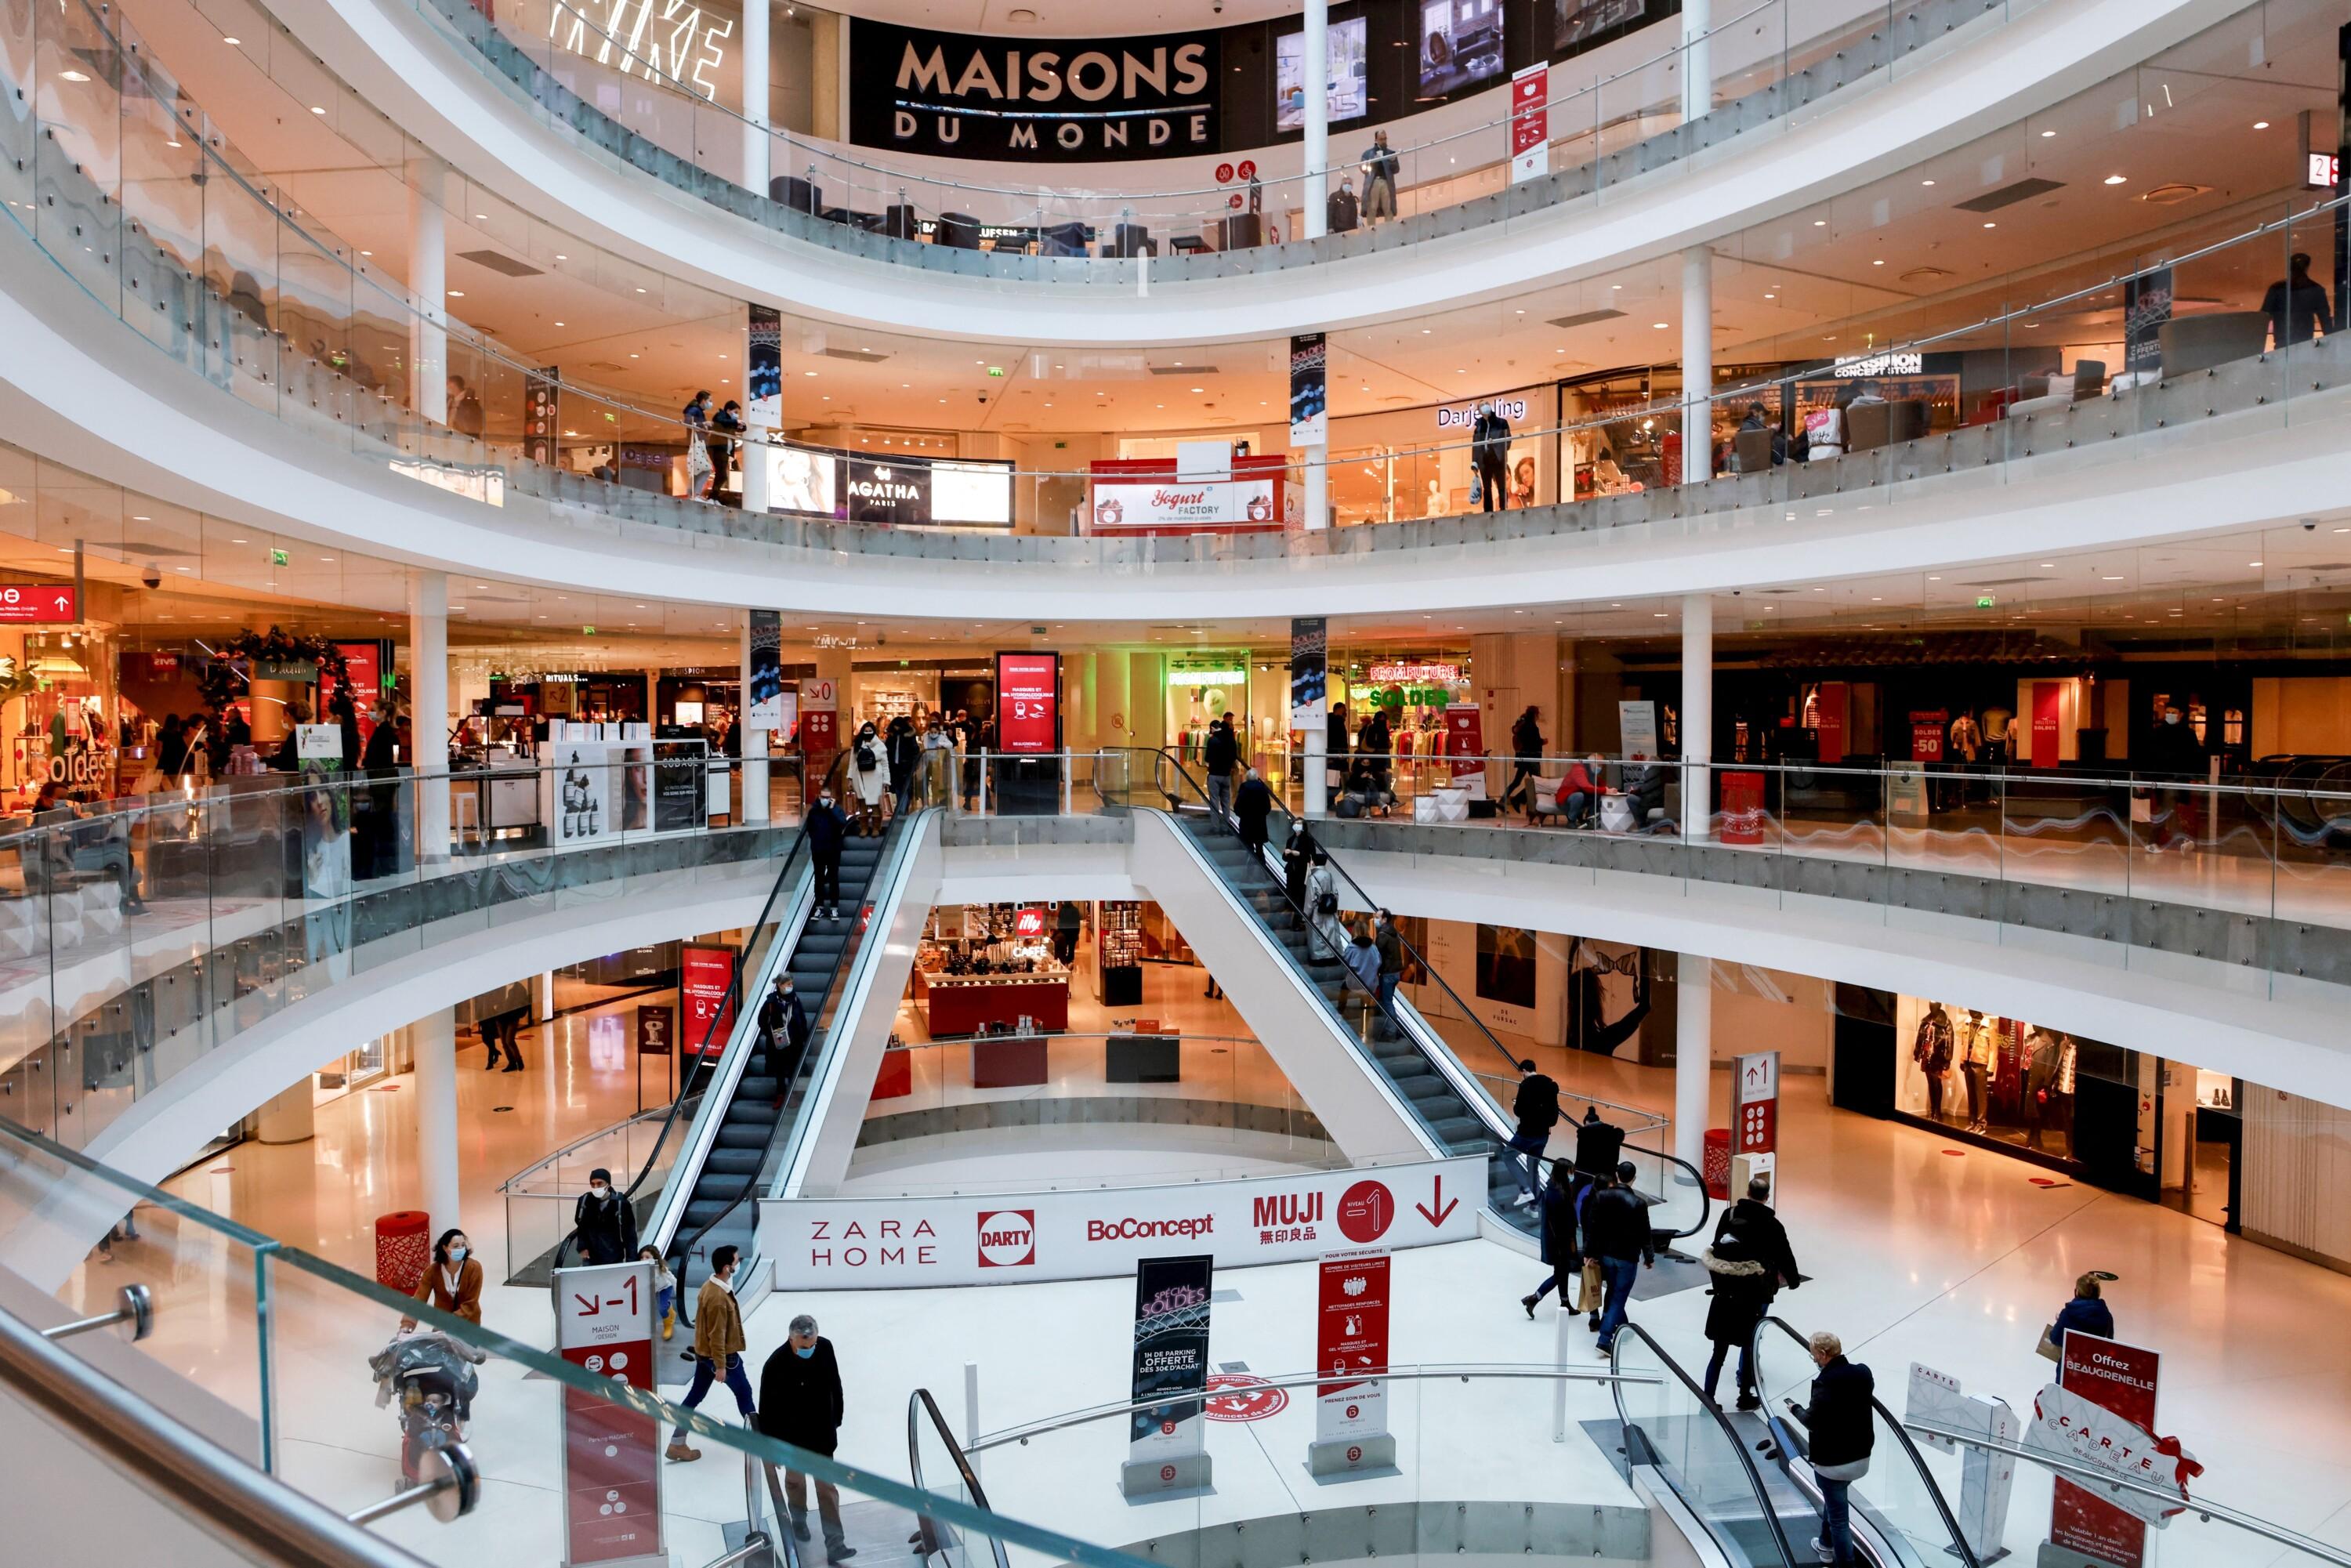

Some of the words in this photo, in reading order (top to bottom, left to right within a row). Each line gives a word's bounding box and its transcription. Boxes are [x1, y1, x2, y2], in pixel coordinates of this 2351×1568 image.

[895, 39, 1208, 102] MAISONS
[895, 110, 960, 143] DU
[1009, 114, 1208, 150] MONDE
[2316, 158, 2324, 176] 2
[1291, 343, 1324, 360] SOLDES
[1835, 367, 1886, 378] CONCEPT
[1888, 365, 1922, 375] STORE
[1439, 398, 1523, 427] Darjeling
[849, 481, 919, 500] AGATHA
[1151, 489, 1204, 509] Yogurt
[1179, 505, 1219, 515] FACTORY
[1370, 690, 1449, 707] SOLDES
[1019, 914, 1041, 933] illy
[1493, 1015, 1517, 1025] FURSAC
[1761, 1059, 1767, 1084] 1
[1254, 1192, 1323, 1227] MUJI
[811, 1219, 936, 1240] ZARA
[1088, 1214, 1213, 1241] BoConcept
[1260, 1226, 1317, 1245] 無印良品
[981, 1230, 1031, 1247] DARTY
[812, 1246, 936, 1266] HOME
[1142, 1287, 1204, 1318] SOLDES
[1154, 1285, 1191, 1301] SPÉCIAL
[592, 1324, 619, 1333] MAISON
[1145, 1356, 1194, 1367] OFFERTE
[1169, 1363, 1199, 1371] D'ACHAT
[2092, 1353, 2129, 1371] Offrez
[1918, 1367, 1954, 1386] CARTE
[2066, 1360, 2154, 1391] BEAUGRENELLE
[2047, 1418, 2164, 1485] CADEAU
[2059, 1416, 2153, 1470] CARTE
[2055, 1527, 2063, 1536] les
[2064, 1530, 2094, 1547] boutiques
[2103, 1543, 2138, 1559] restaurants
[2070, 1525, 2092, 1537] Valable
[2107, 1534, 2122, 1547] dans
[2072, 1541, 2111, 1559] Beaugrenelle
[2112, 1552, 2128, 1563] Paris
